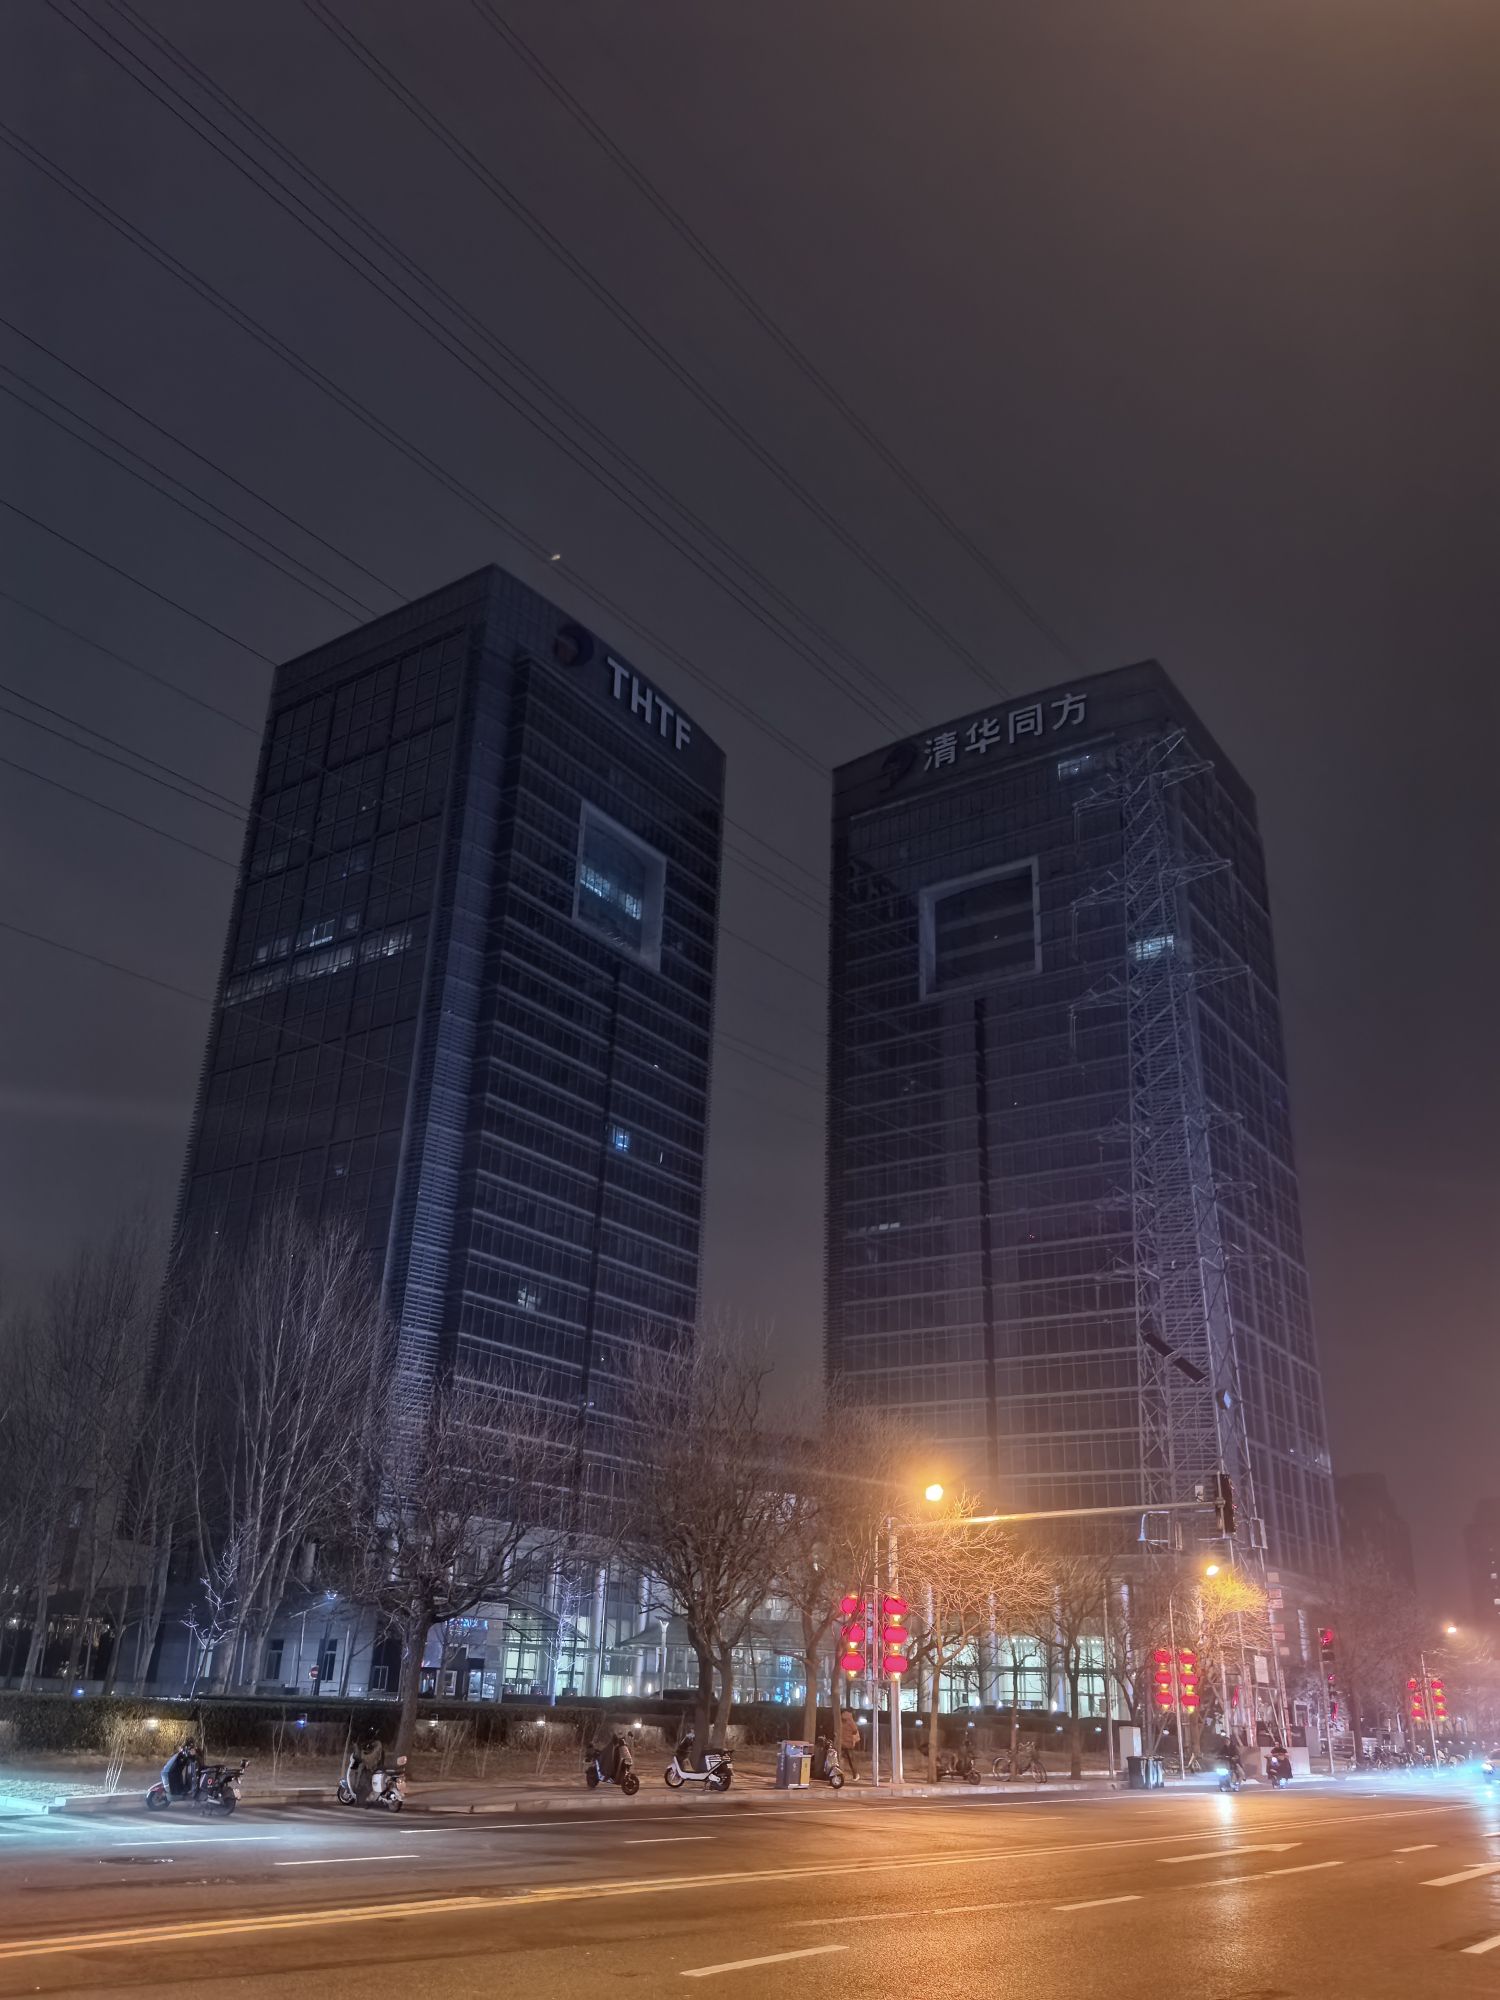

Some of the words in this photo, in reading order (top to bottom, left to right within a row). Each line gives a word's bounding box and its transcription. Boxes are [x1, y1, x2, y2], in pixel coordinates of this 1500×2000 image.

[607, 656, 691, 750] THTF
[923, 693, 1087, 772] 清华同方
